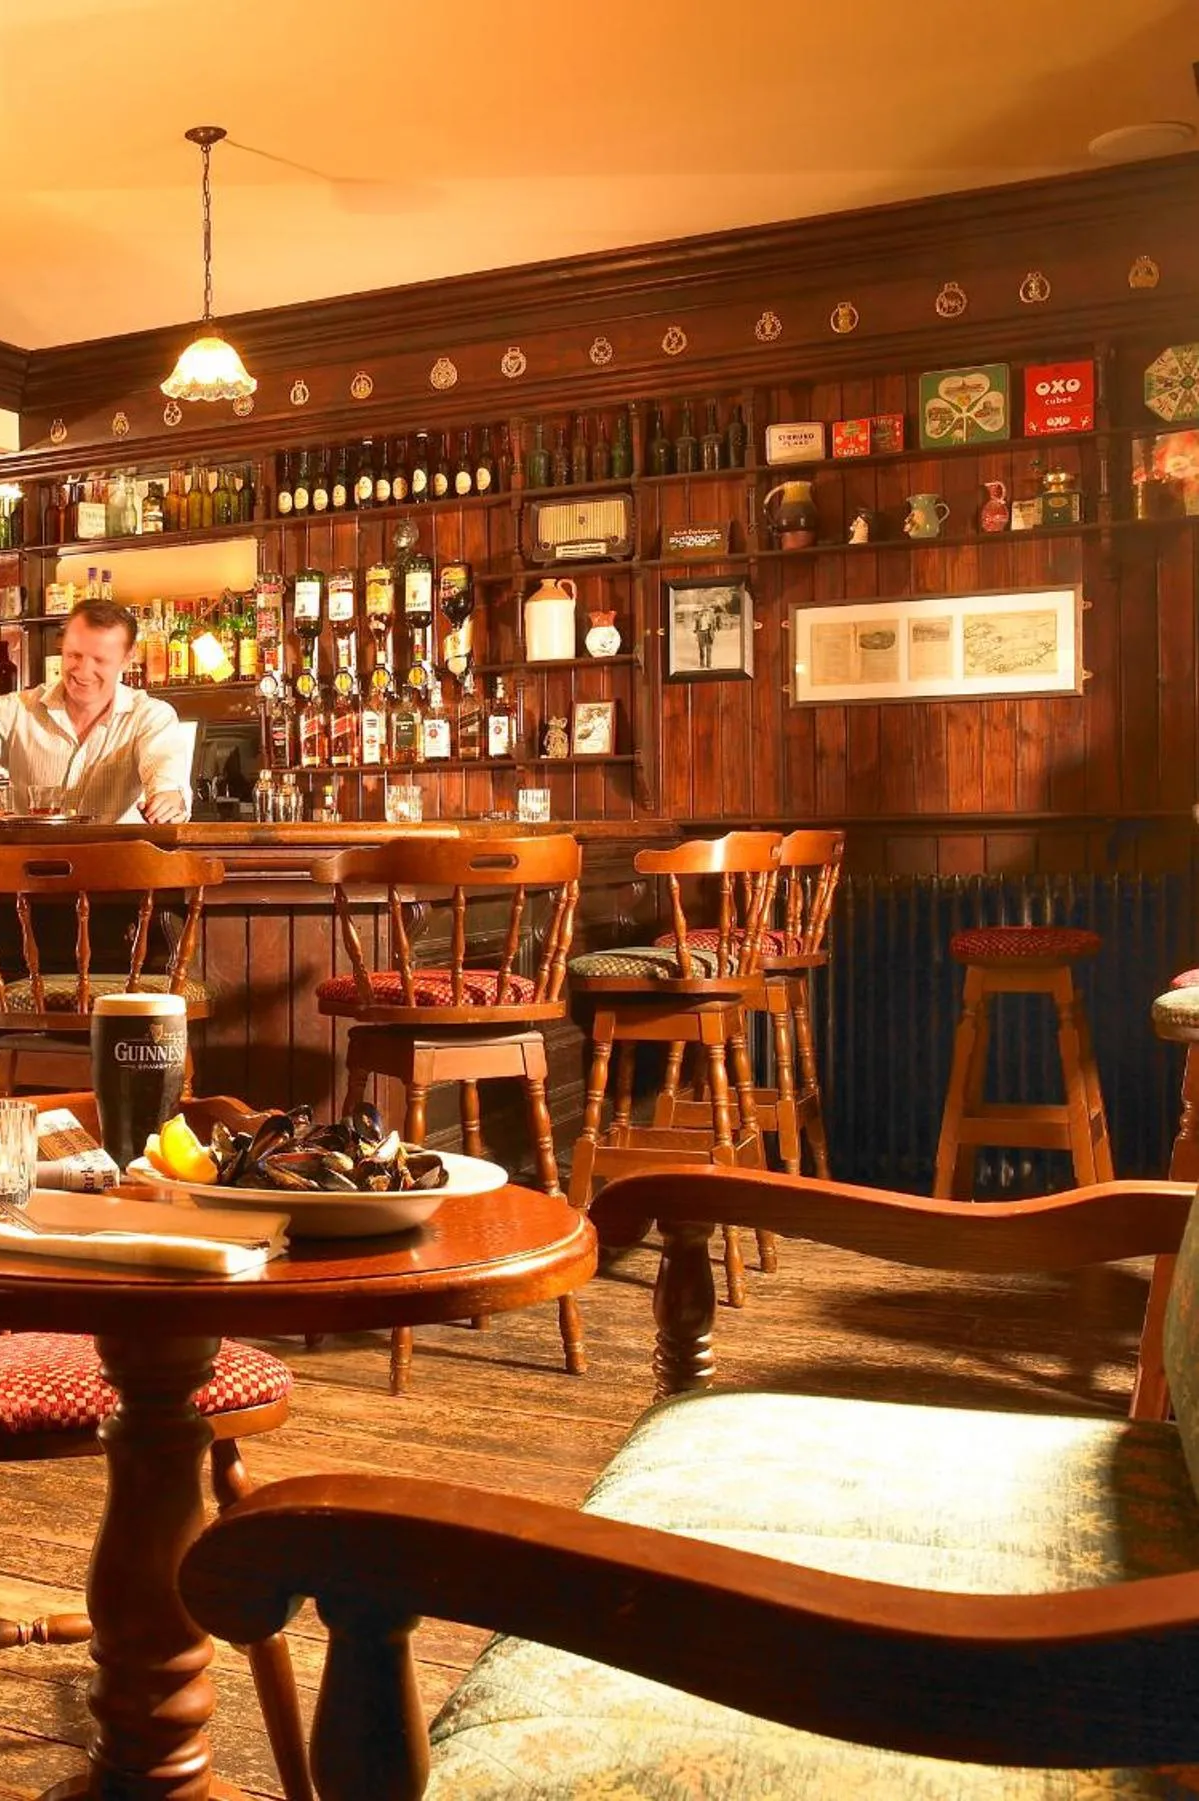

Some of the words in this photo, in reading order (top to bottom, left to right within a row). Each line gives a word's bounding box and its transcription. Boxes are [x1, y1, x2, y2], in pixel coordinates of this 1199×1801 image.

[1035, 378, 1081, 396] OXO
[1044, 396, 1073, 405] cubes
[114, 1042, 185, 1062] GUINNES
